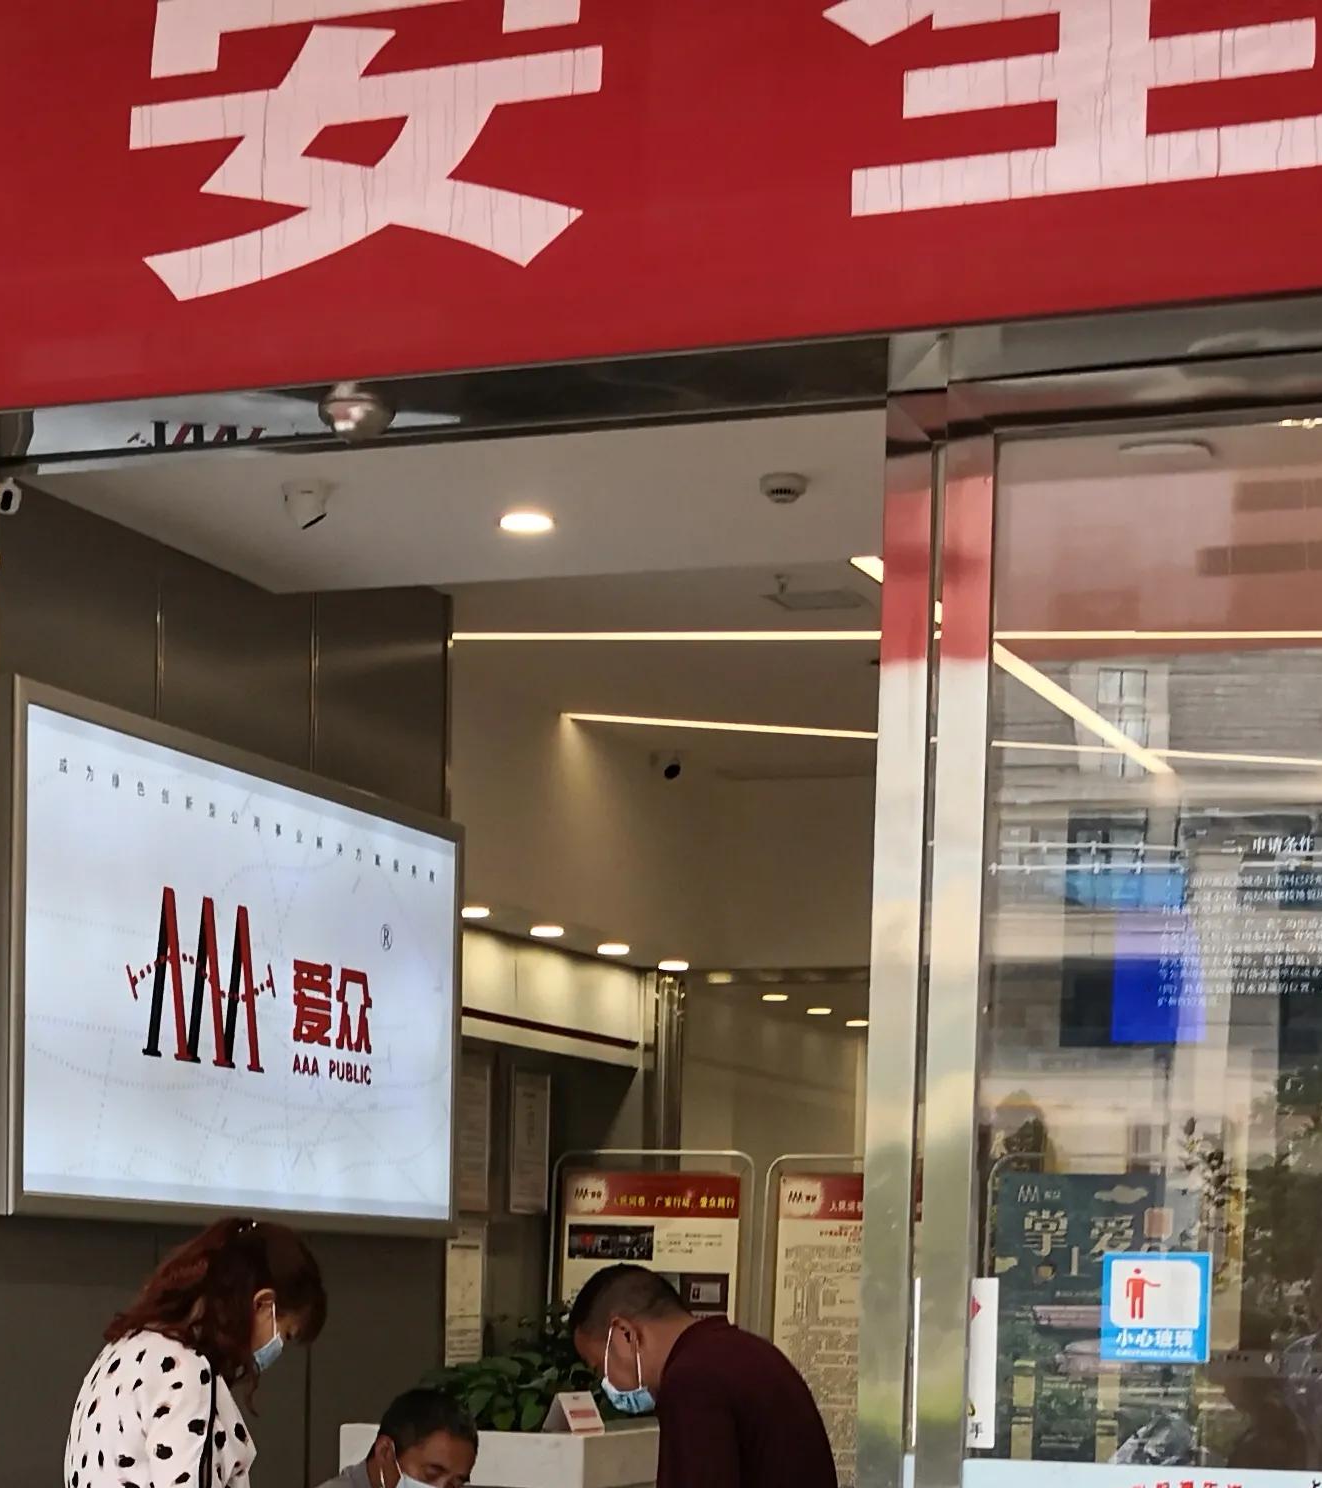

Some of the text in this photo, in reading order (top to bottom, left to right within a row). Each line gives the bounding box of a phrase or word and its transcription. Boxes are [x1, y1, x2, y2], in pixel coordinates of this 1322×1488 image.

[292, 957, 373, 1055] 爱众
[292, 1053, 373, 1086] AAA PUBLIC
[1115, 1327, 1194, 1350] 小心玻璃
